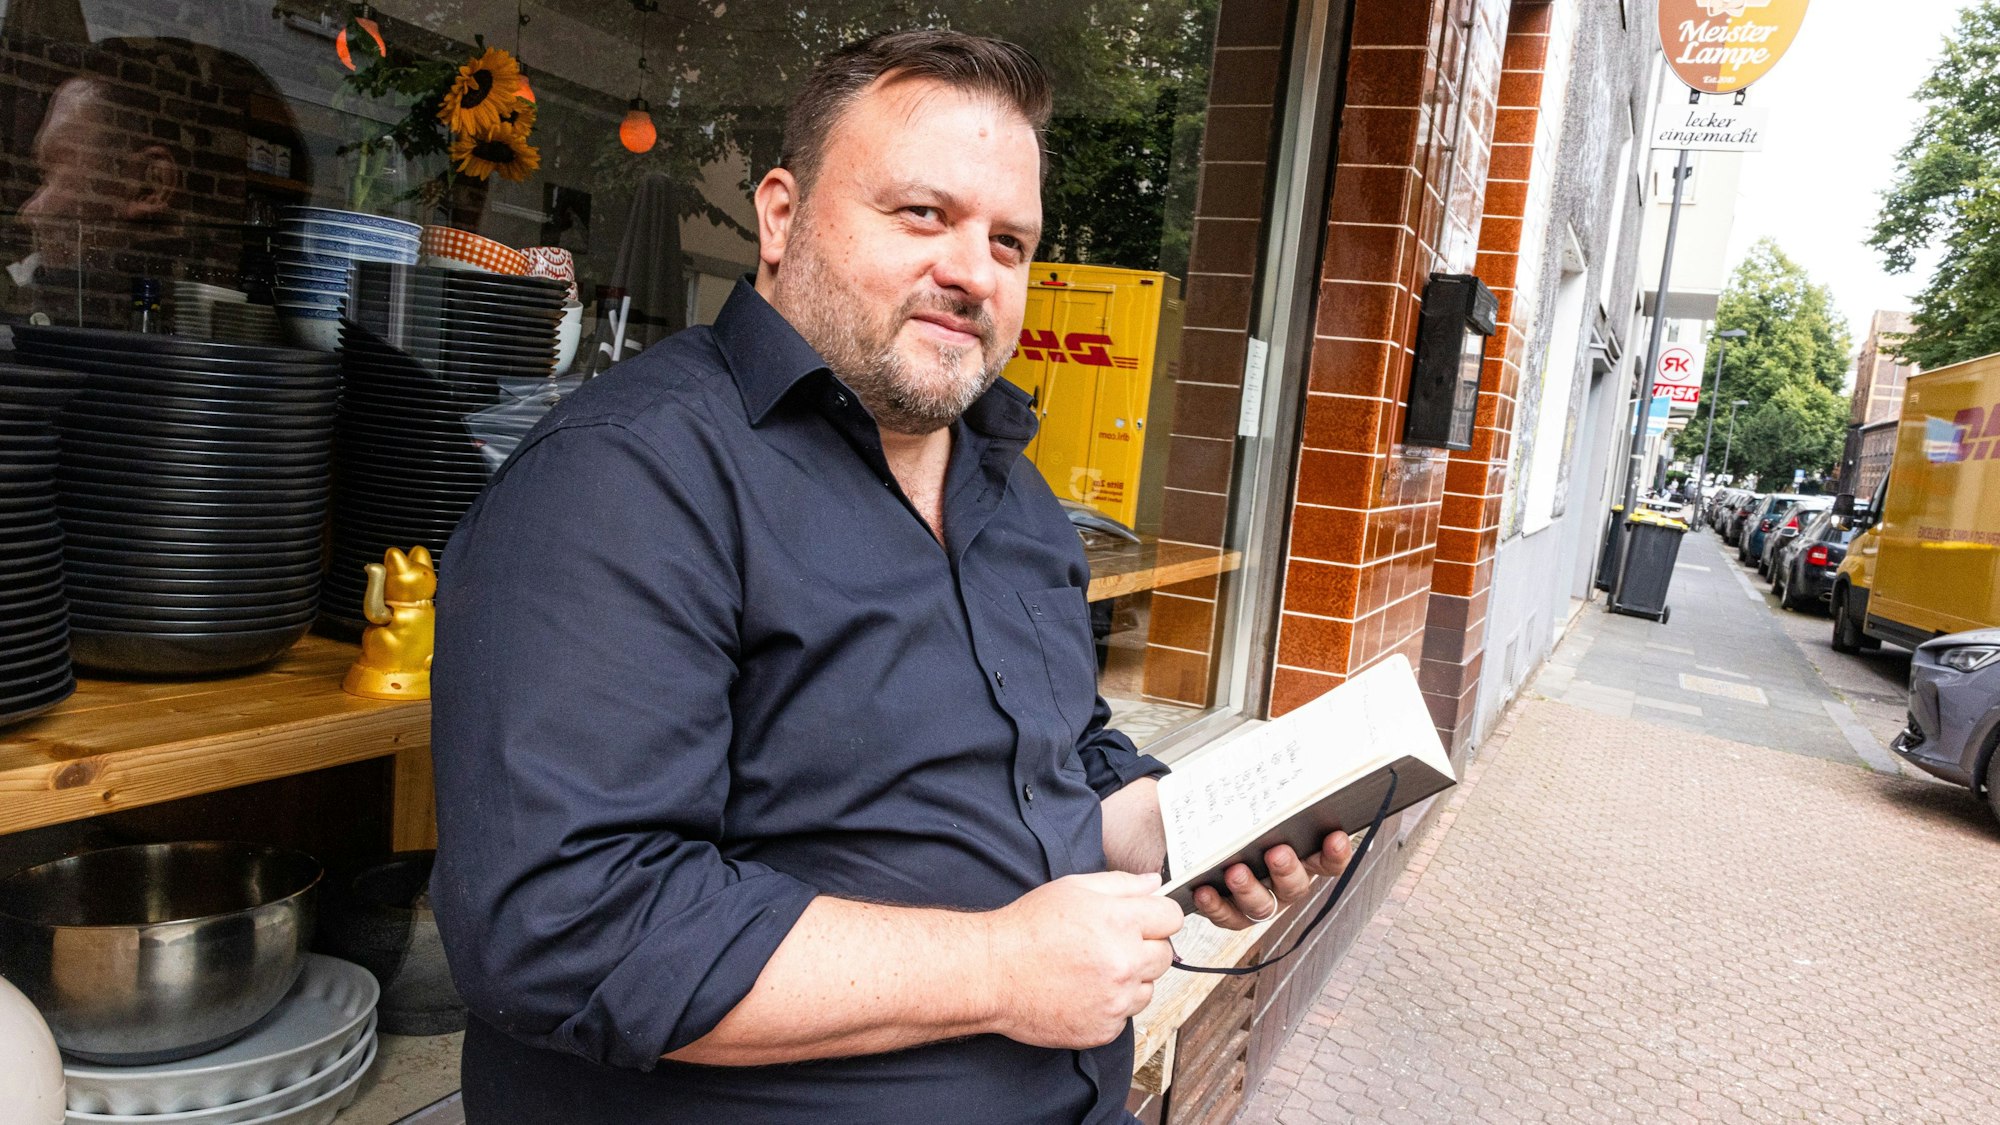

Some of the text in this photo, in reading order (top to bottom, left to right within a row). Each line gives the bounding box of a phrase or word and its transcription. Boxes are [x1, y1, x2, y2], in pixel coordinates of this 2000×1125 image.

[1678, 19, 1778, 43] Meister
[1675, 41, 1771, 71] Lampe
[1685, 110, 1736, 128] lecker
[1659, 128, 1758, 146] eingemacht
